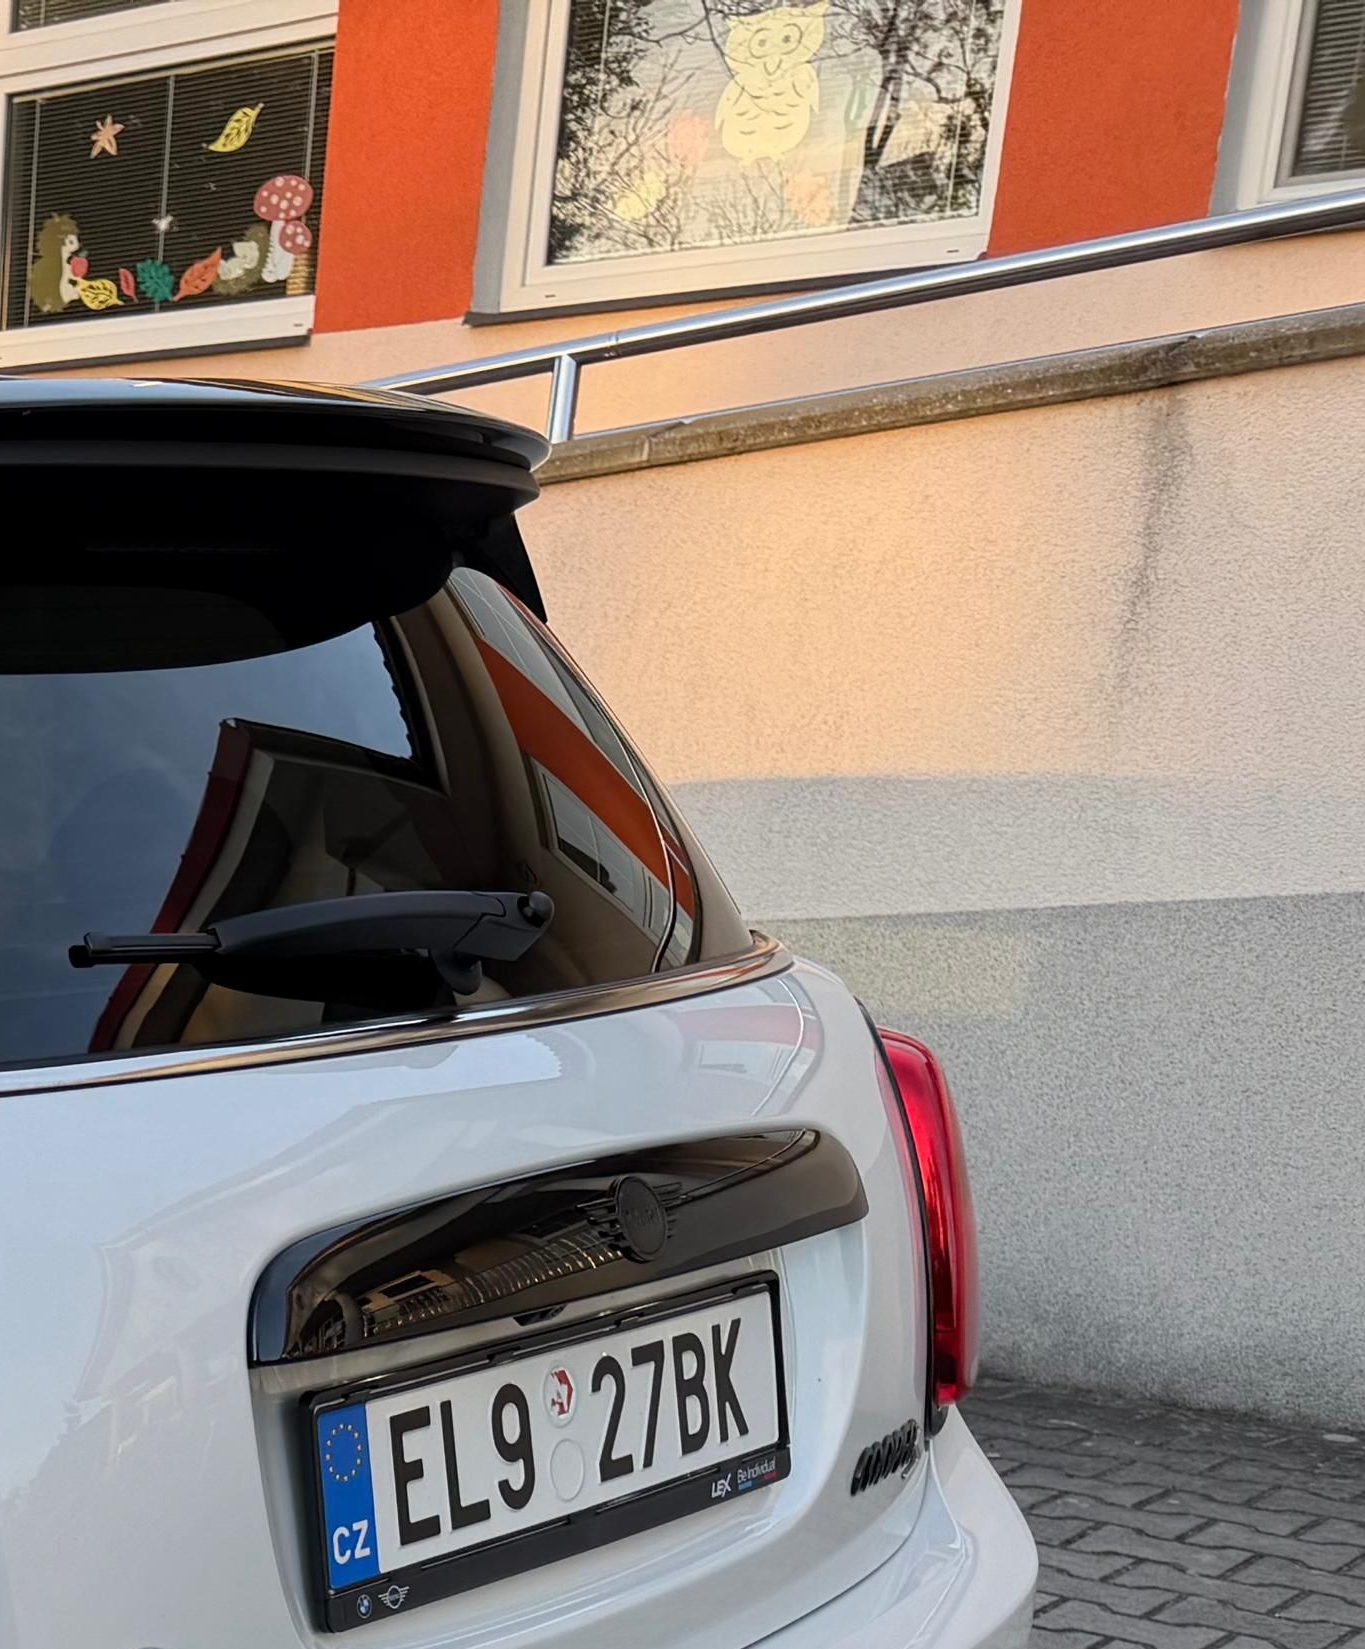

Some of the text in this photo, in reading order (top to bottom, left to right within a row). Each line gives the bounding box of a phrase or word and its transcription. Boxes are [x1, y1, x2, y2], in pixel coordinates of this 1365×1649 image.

[389, 1317, 749, 1547] EL9 27BK
[711, 1472, 732, 1498] LEX
[332, 1518, 370, 1565] CZ
